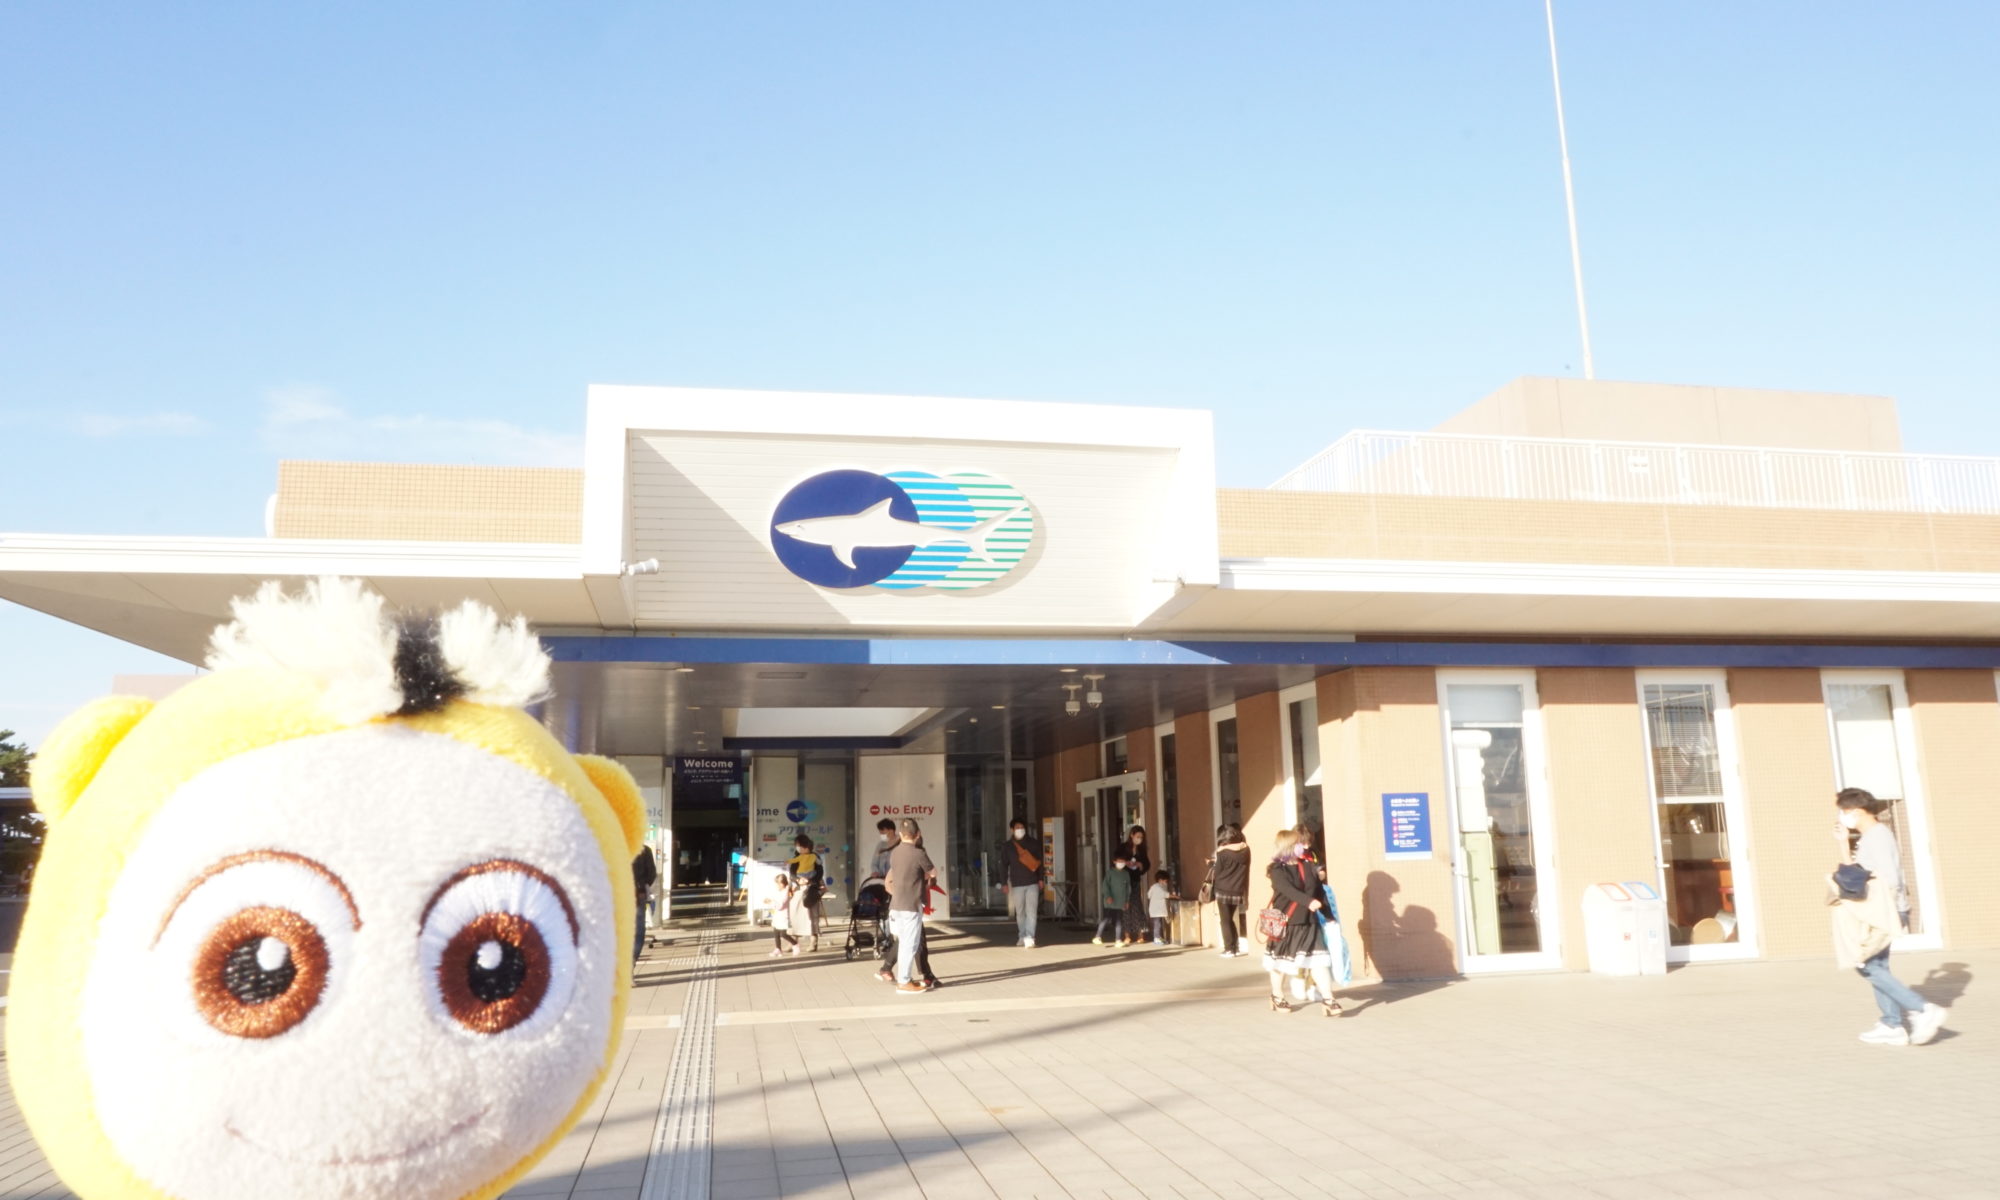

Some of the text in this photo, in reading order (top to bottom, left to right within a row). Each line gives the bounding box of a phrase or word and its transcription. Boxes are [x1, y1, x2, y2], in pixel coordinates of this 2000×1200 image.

[684, 759, 734, 768] Welcome
[883, 805, 935, 816] No Entry
